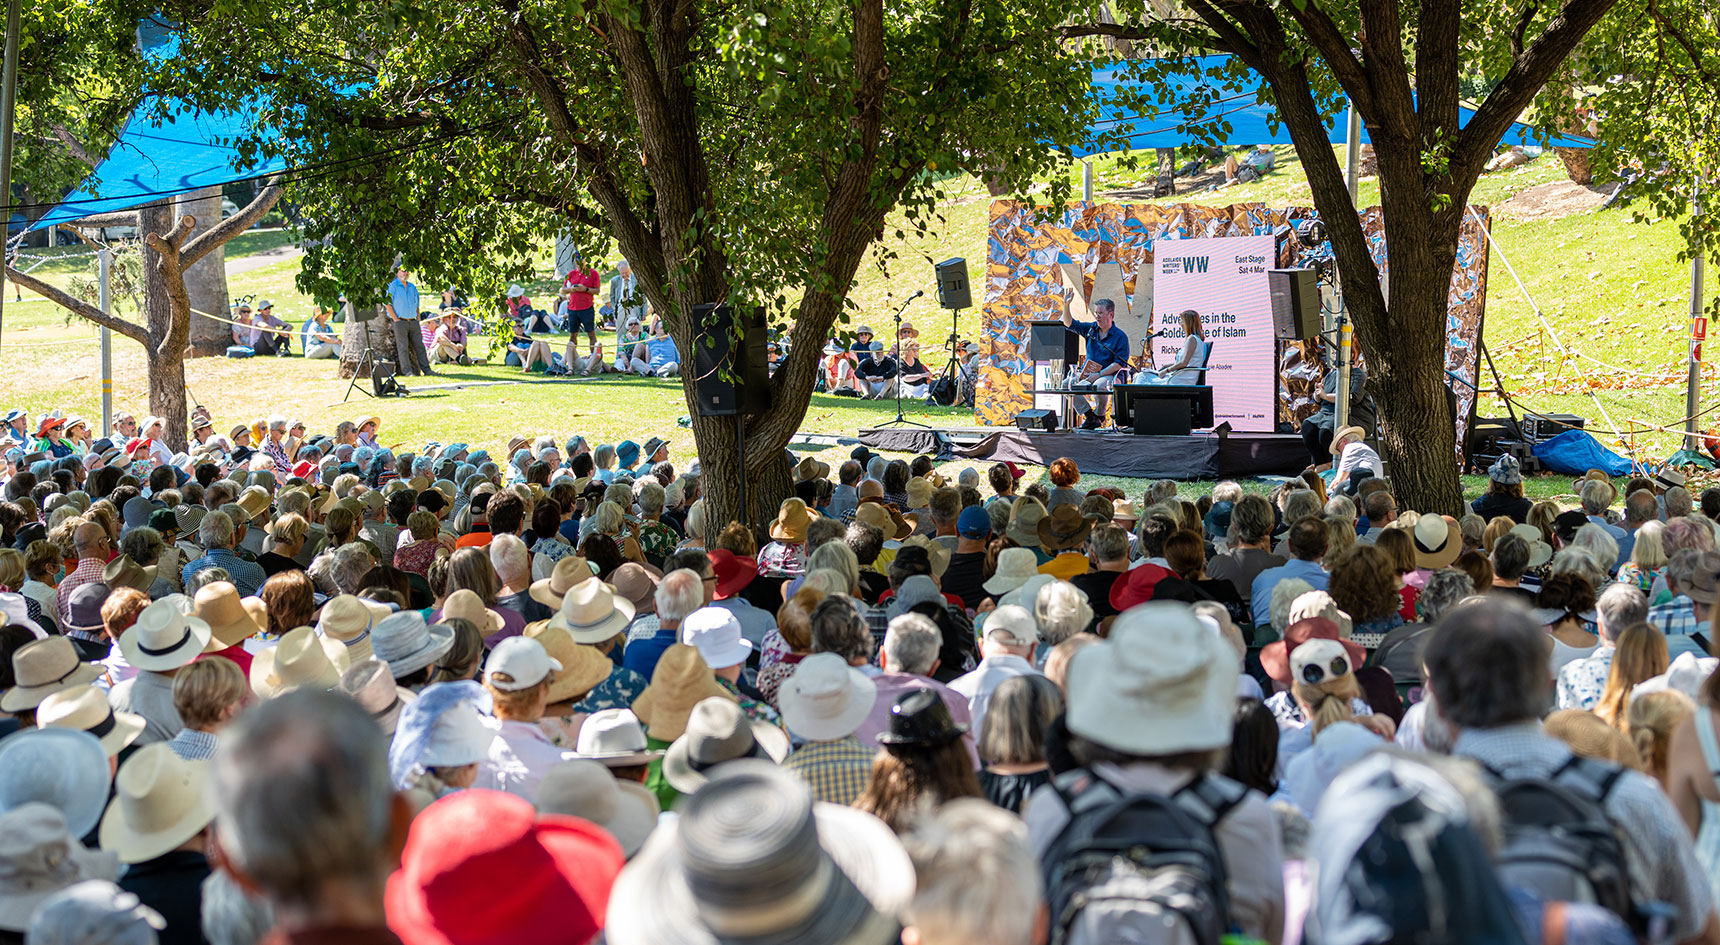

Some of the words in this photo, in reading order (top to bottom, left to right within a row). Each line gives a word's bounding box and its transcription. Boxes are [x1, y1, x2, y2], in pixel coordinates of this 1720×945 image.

[1183, 256, 1209, 273] WW
[1235, 255, 1248, 264] East
[1248, 255, 1265, 264] Stage
[1239, 266, 1248, 274] Sat
[1254, 266, 1265, 274] Mar
[1162, 313, 1210, 324] Advees
[1212, 313, 1220, 323] in
[1221, 312, 1236, 323] the
[1162, 327, 1187, 338] Golde
[1212, 327, 1221, 337] of
[1223, 326, 1246, 338] Islam
[1161, 346, 1181, 354] Richa
